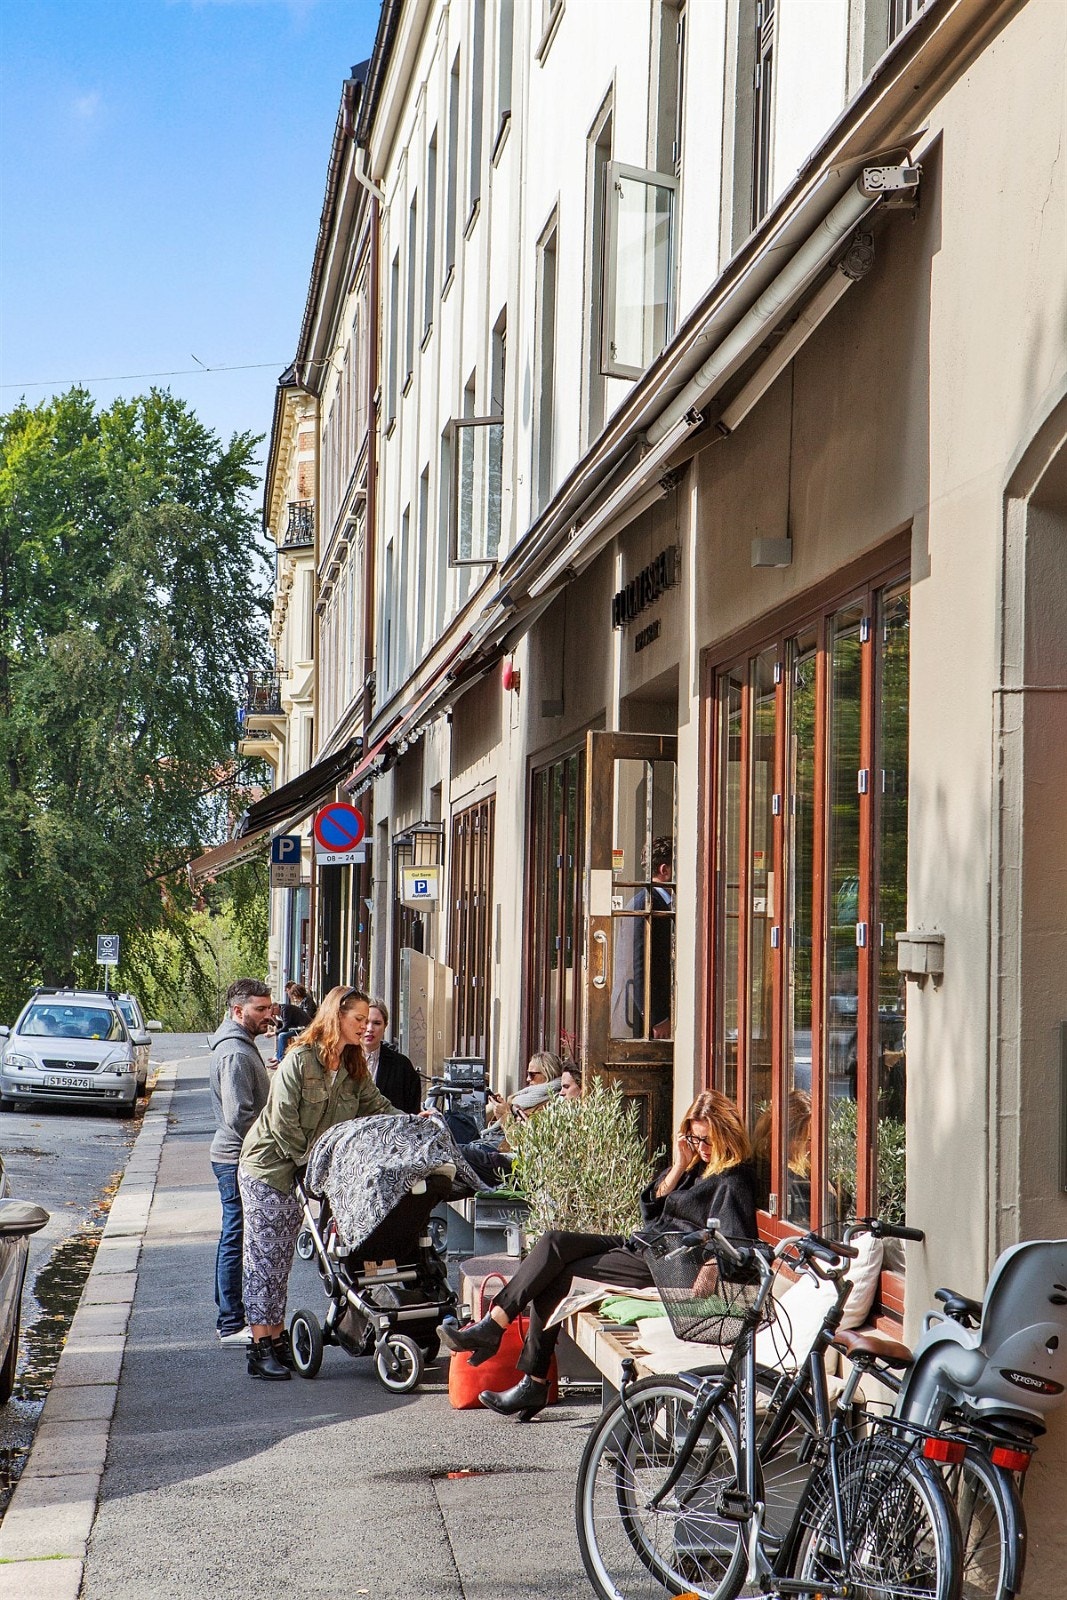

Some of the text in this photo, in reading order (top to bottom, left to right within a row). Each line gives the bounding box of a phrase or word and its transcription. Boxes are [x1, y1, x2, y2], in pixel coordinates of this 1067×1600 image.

[279, 838, 294, 860] P
[417, 882, 426, 892] P
[50, 1077, 88, 1087] ST 59476
